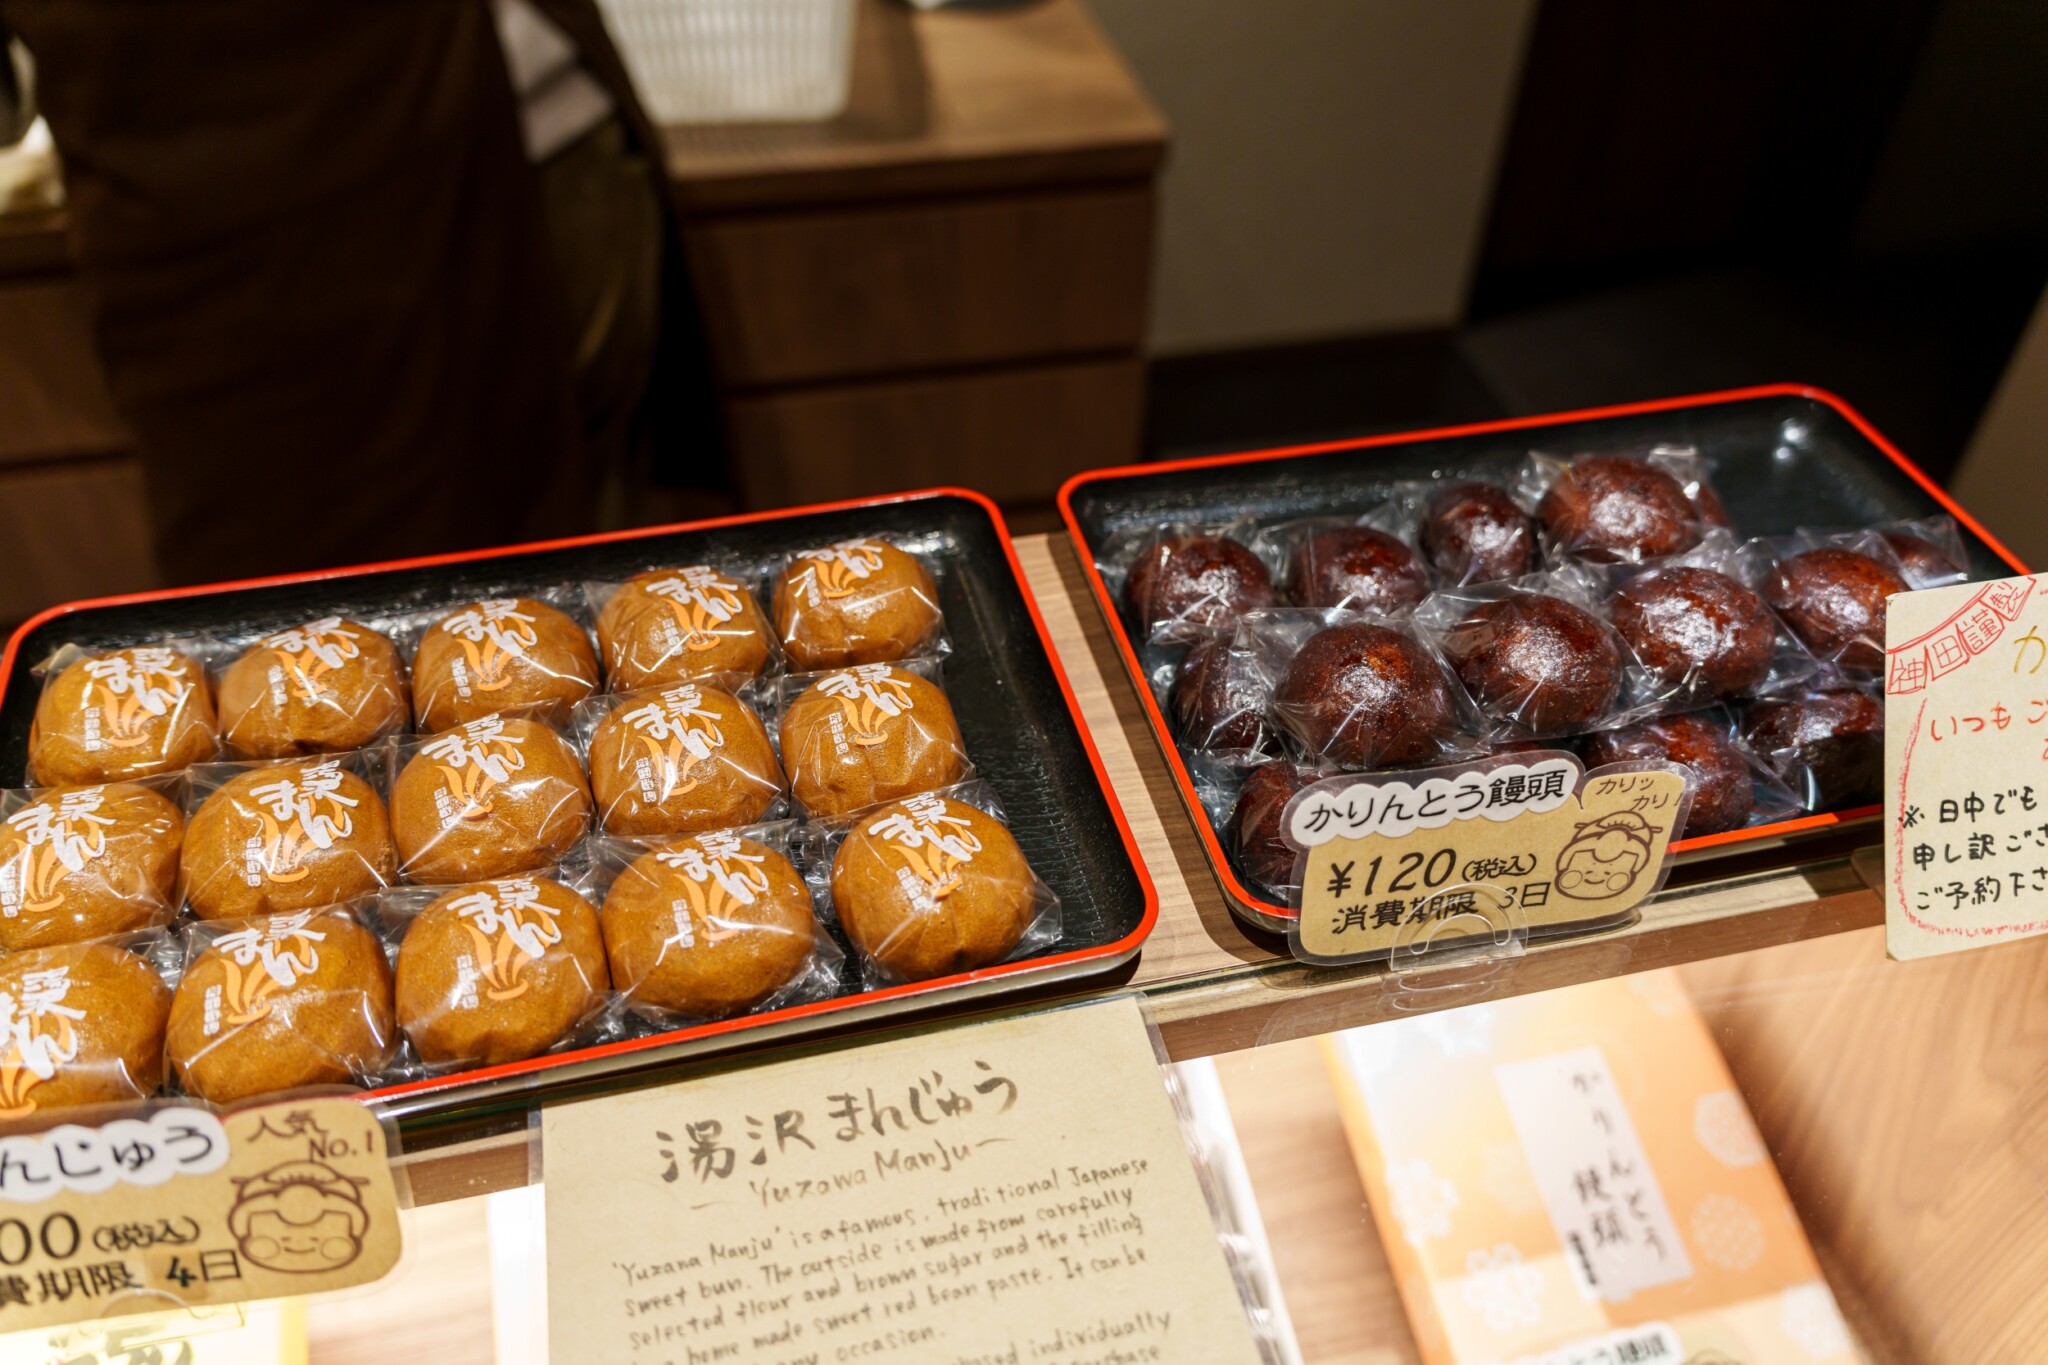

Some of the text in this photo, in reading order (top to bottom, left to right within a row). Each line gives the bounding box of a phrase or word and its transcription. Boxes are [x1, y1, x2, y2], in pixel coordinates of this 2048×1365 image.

[1893, 576, 2025, 690] 神田謹製
[1303, 768, 1569, 833] かりんとう饅頭
[1938, 785, 2037, 823] 日中でも
[1327, 848, 1538, 899] ¥120 (税込)
[1331, 881, 1552, 935] 消費期限 3日
[246, 1108, 328, 1143] 人気
[656, 1058, 1019, 1184] 湯沢まんじゅう
[749, 1167, 867, 1207] Yuzawa
[1067, 1156, 1150, 1188] Japanese
[93, 1215, 201, 1253] (税込)
[624, 1187, 1135, 1318] sweet bun. The outside is made from carefully
[167, 1248, 243, 1288] 4日
[629, 1212, 1144, 1350] selected flour and brown sugar and the filling
[752, 1318, 804, 1350] made
[813, 1302, 873, 1335] sweet
[884, 1289, 918, 1318] red
[927, 1282, 979, 1307] bean
[985, 1268, 1054, 1303] paste.
[1058, 1256, 1084, 1280] It
[1089, 1255, 1122, 1274] can
[1123, 1242, 1147, 1267] be
